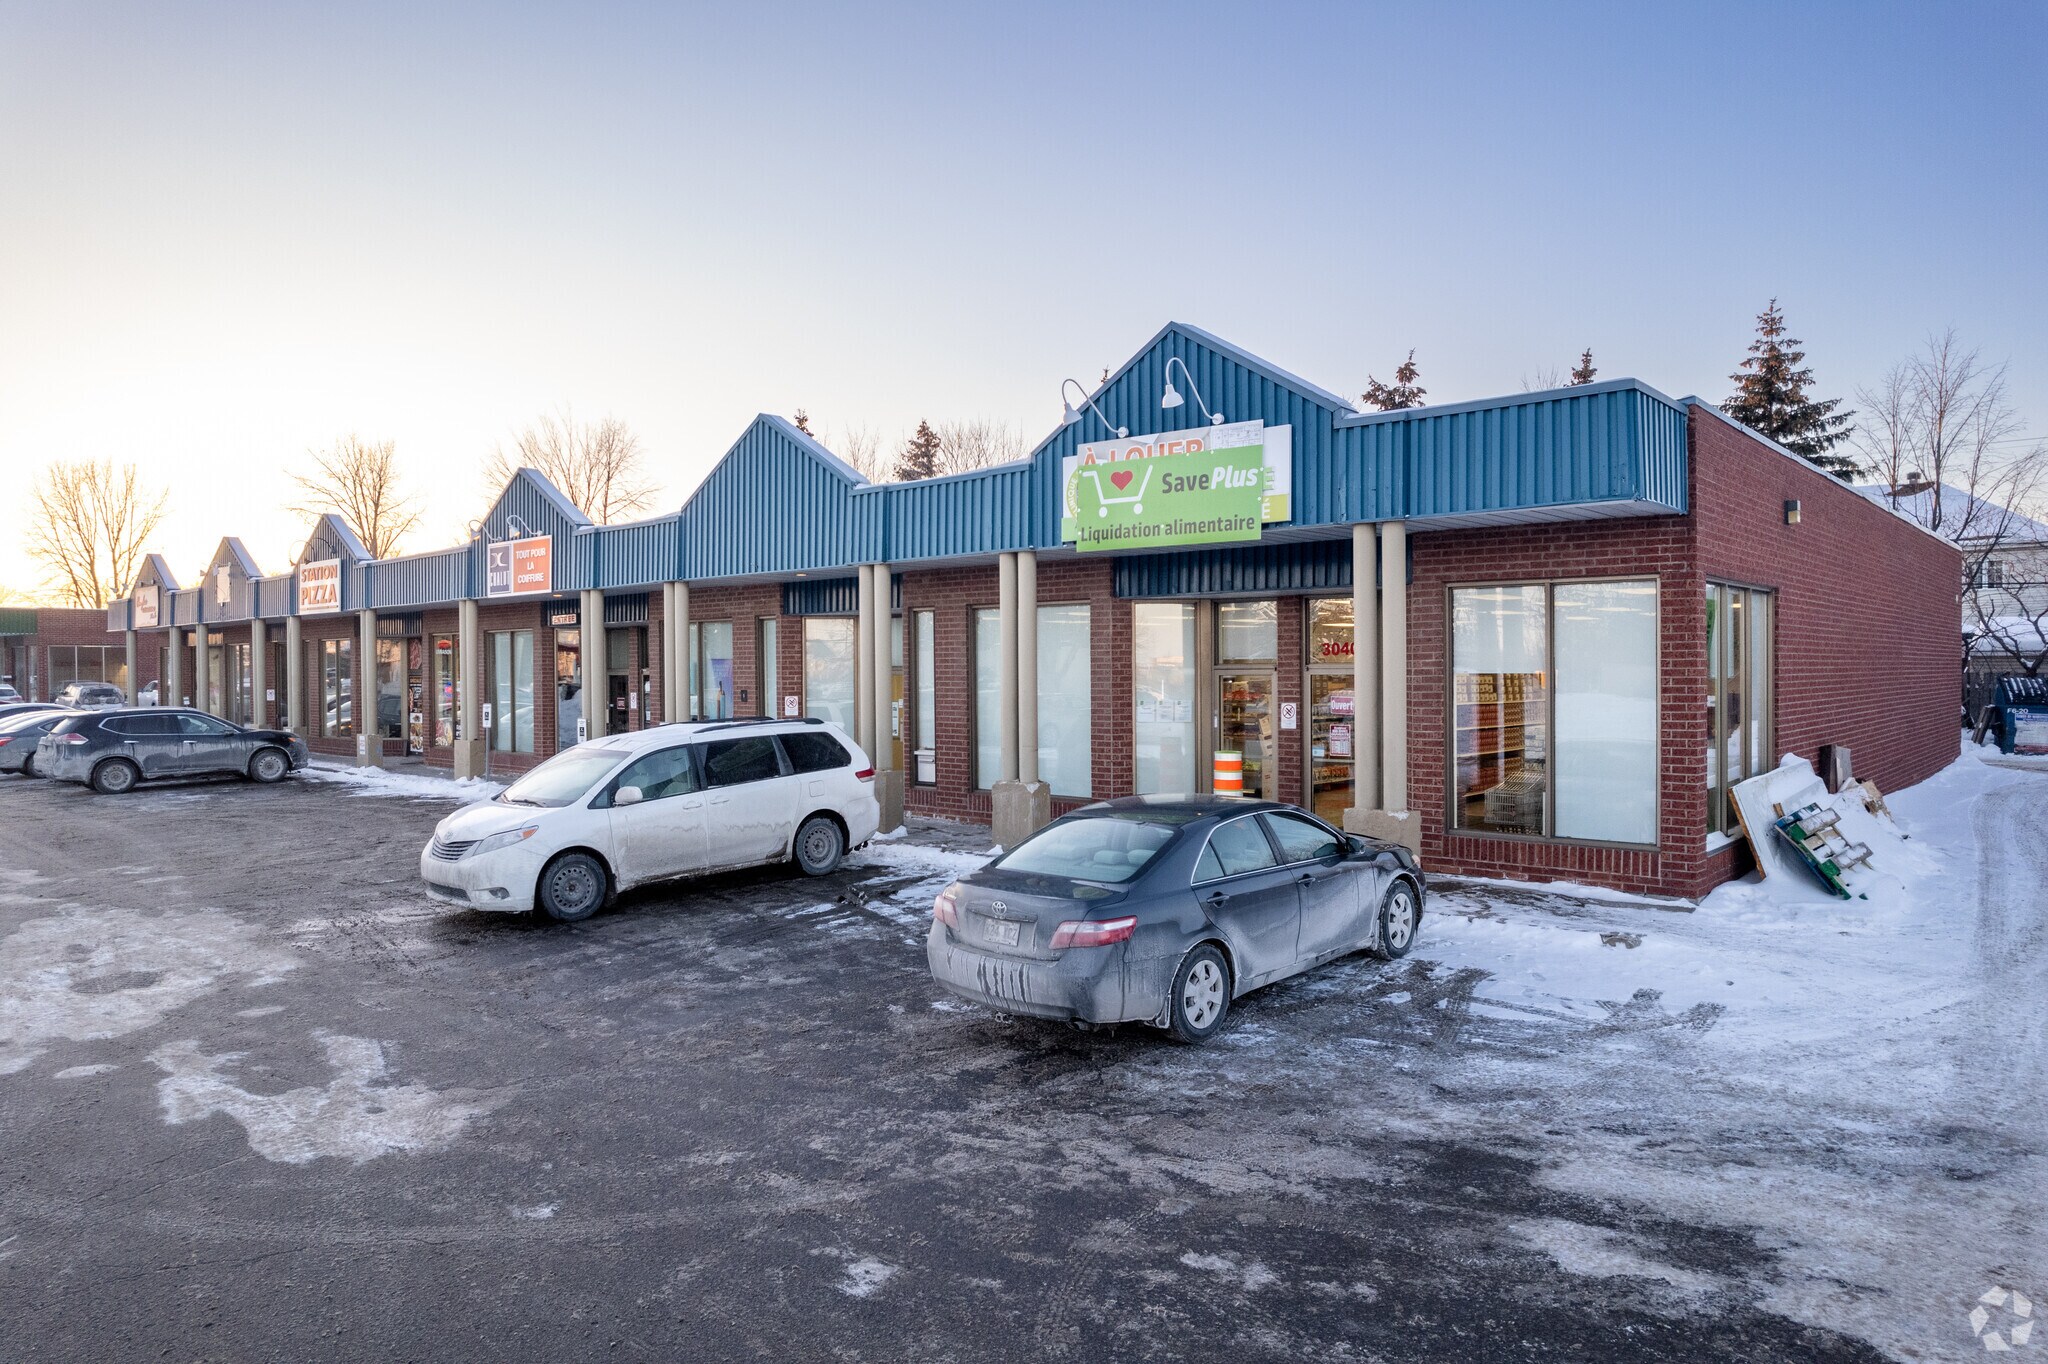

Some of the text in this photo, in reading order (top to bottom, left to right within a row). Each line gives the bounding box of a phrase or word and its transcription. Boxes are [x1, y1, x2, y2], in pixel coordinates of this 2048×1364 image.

[1080, 514, 1255, 544] Liquidation alimentaire
[516, 548, 546, 559] TOUT POUR
[527, 562, 534, 570] LA
[301, 565, 337, 582] STATION
[518, 573, 544, 583] COIFFURE
[301, 584, 337, 605] PIZZA
[1331, 701, 1353, 710] Ouvert
